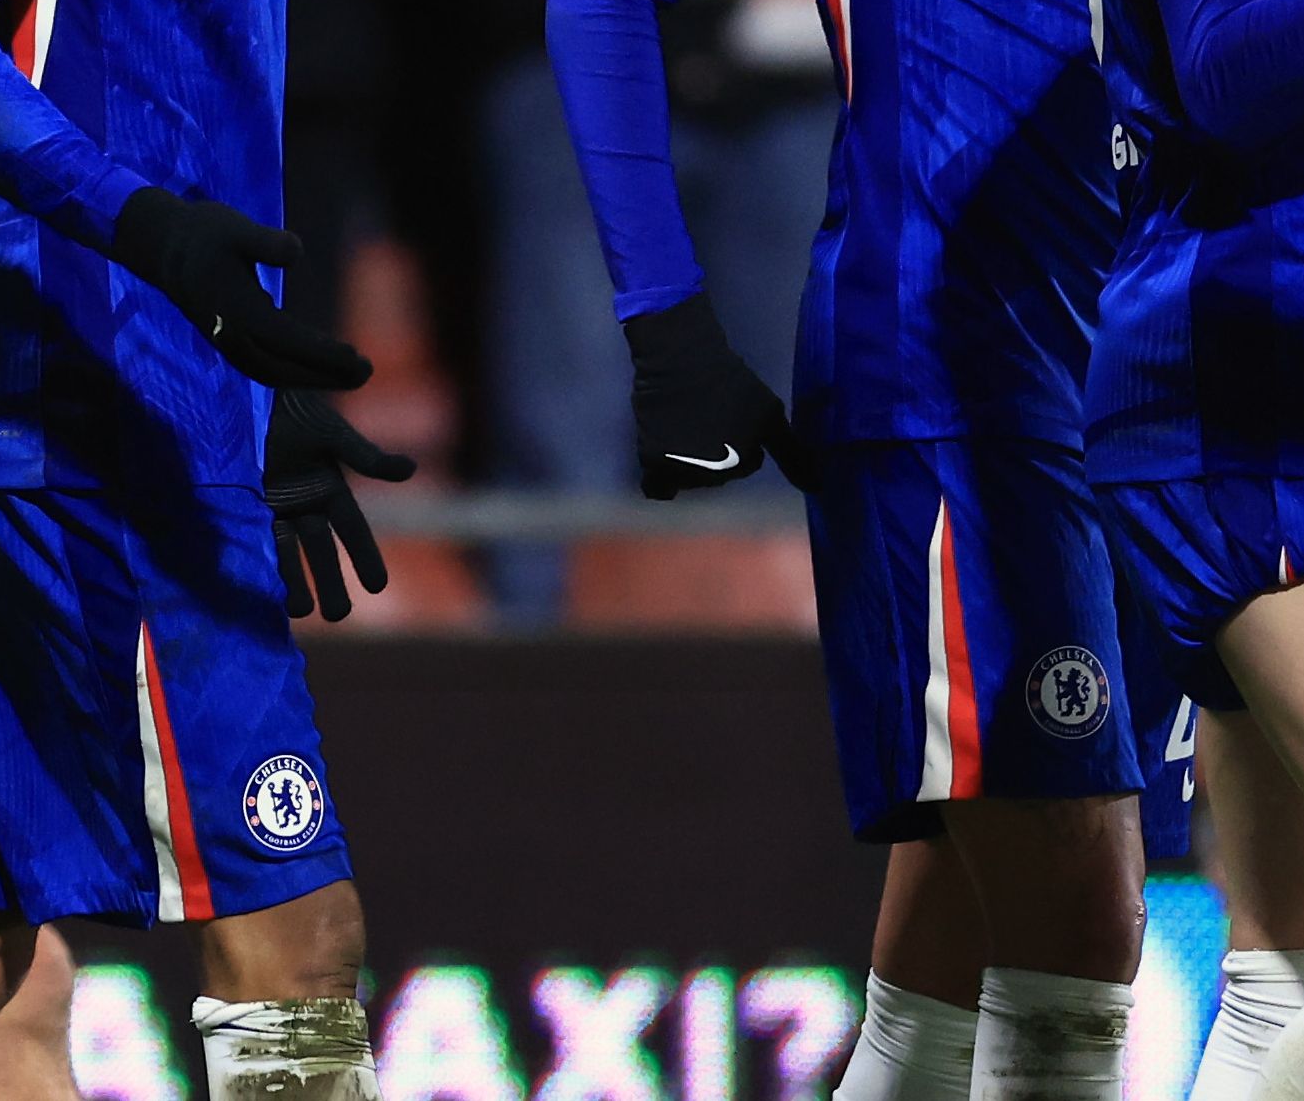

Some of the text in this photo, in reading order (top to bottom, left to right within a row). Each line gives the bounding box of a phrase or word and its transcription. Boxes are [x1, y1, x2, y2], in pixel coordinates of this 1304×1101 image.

[1041, 650, 1094, 670] CHELSEA
[255, 759, 303, 785] CHELSEA
[264, 833, 301, 846] FOOTBALL
[357, 963, 867, 1101] AXI?
